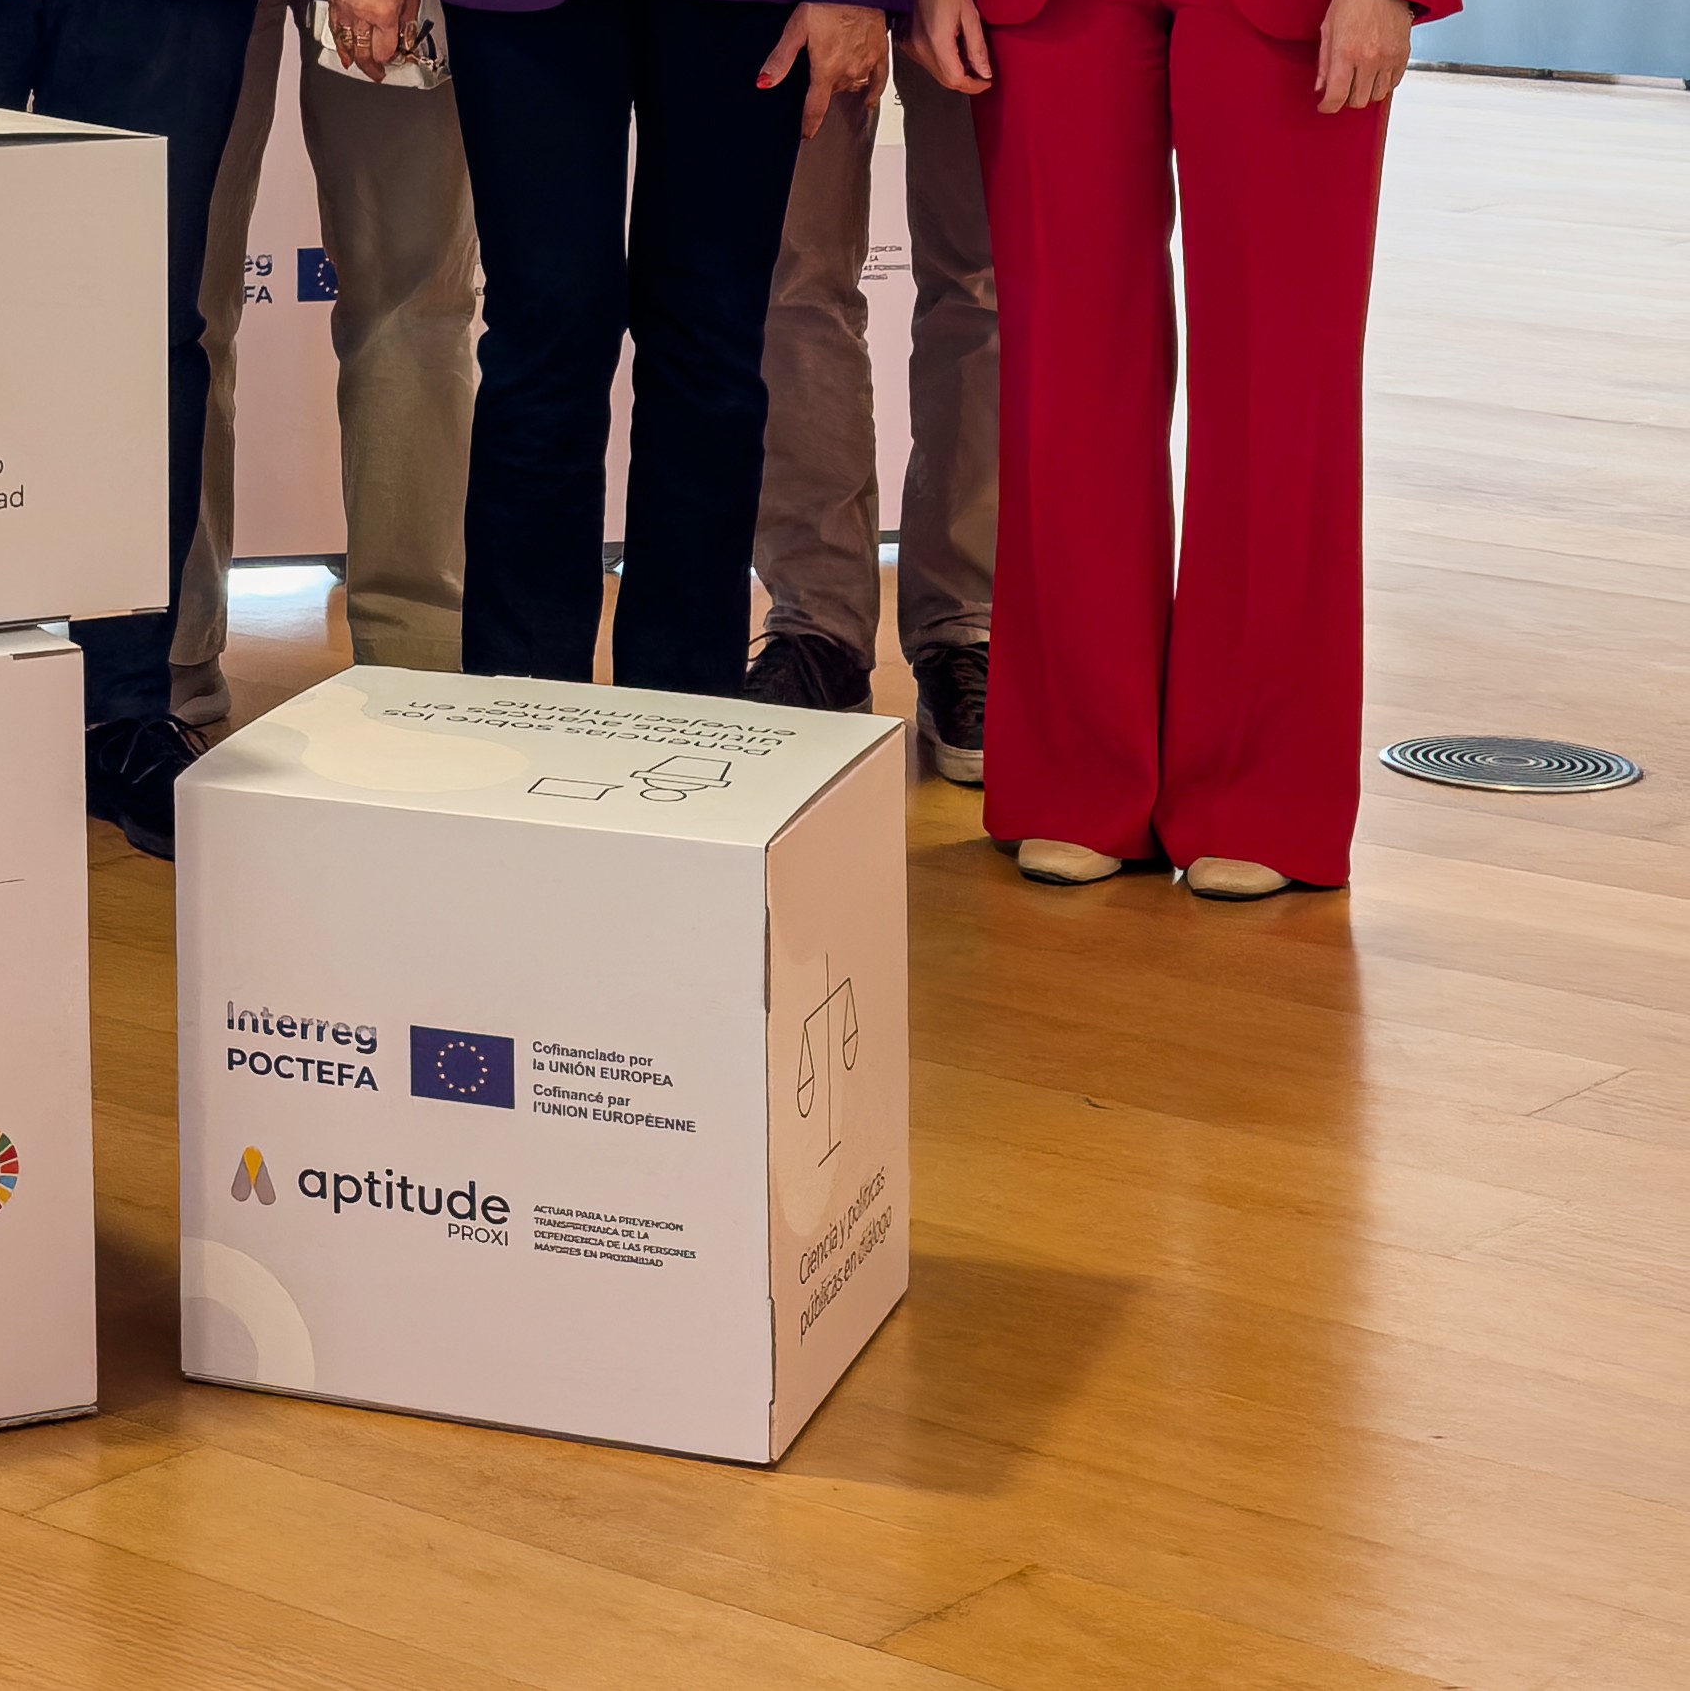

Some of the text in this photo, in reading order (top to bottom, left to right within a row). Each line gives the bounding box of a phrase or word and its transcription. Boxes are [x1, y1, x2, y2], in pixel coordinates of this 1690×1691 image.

[446, 714, 555, 731] sobre
[467, 706, 622, 727] avances
[492, 699, 799, 737] envejecimiento
[227, 1000, 379, 1055] Interreg
[532, 1041, 653, 1068] Cofinanciado por
[227, 1047, 379, 1092] POCTEFA
[533, 1058, 674, 1087] la UNIÓN EUROPEA
[533, 1083, 631, 1108] Cofinancé par
[533, 1100, 697, 1132] l'UNION EUROPÉENNE
[298, 1168, 511, 1226] aptitude
[533, 1204, 573, 1218] ACTUAR
[448, 1222, 509, 1246] PROXI
[606, 1239, 620, 1249] DE
[622, 1242, 641, 1251] LAS
[622, 1228, 635, 1238] DE
[637, 1231, 650, 1240] LA
[534, 1242, 581, 1256] MAYORES
[583, 1249, 597, 1259] EN
[799, 1223, 838, 1285] Ciencia
